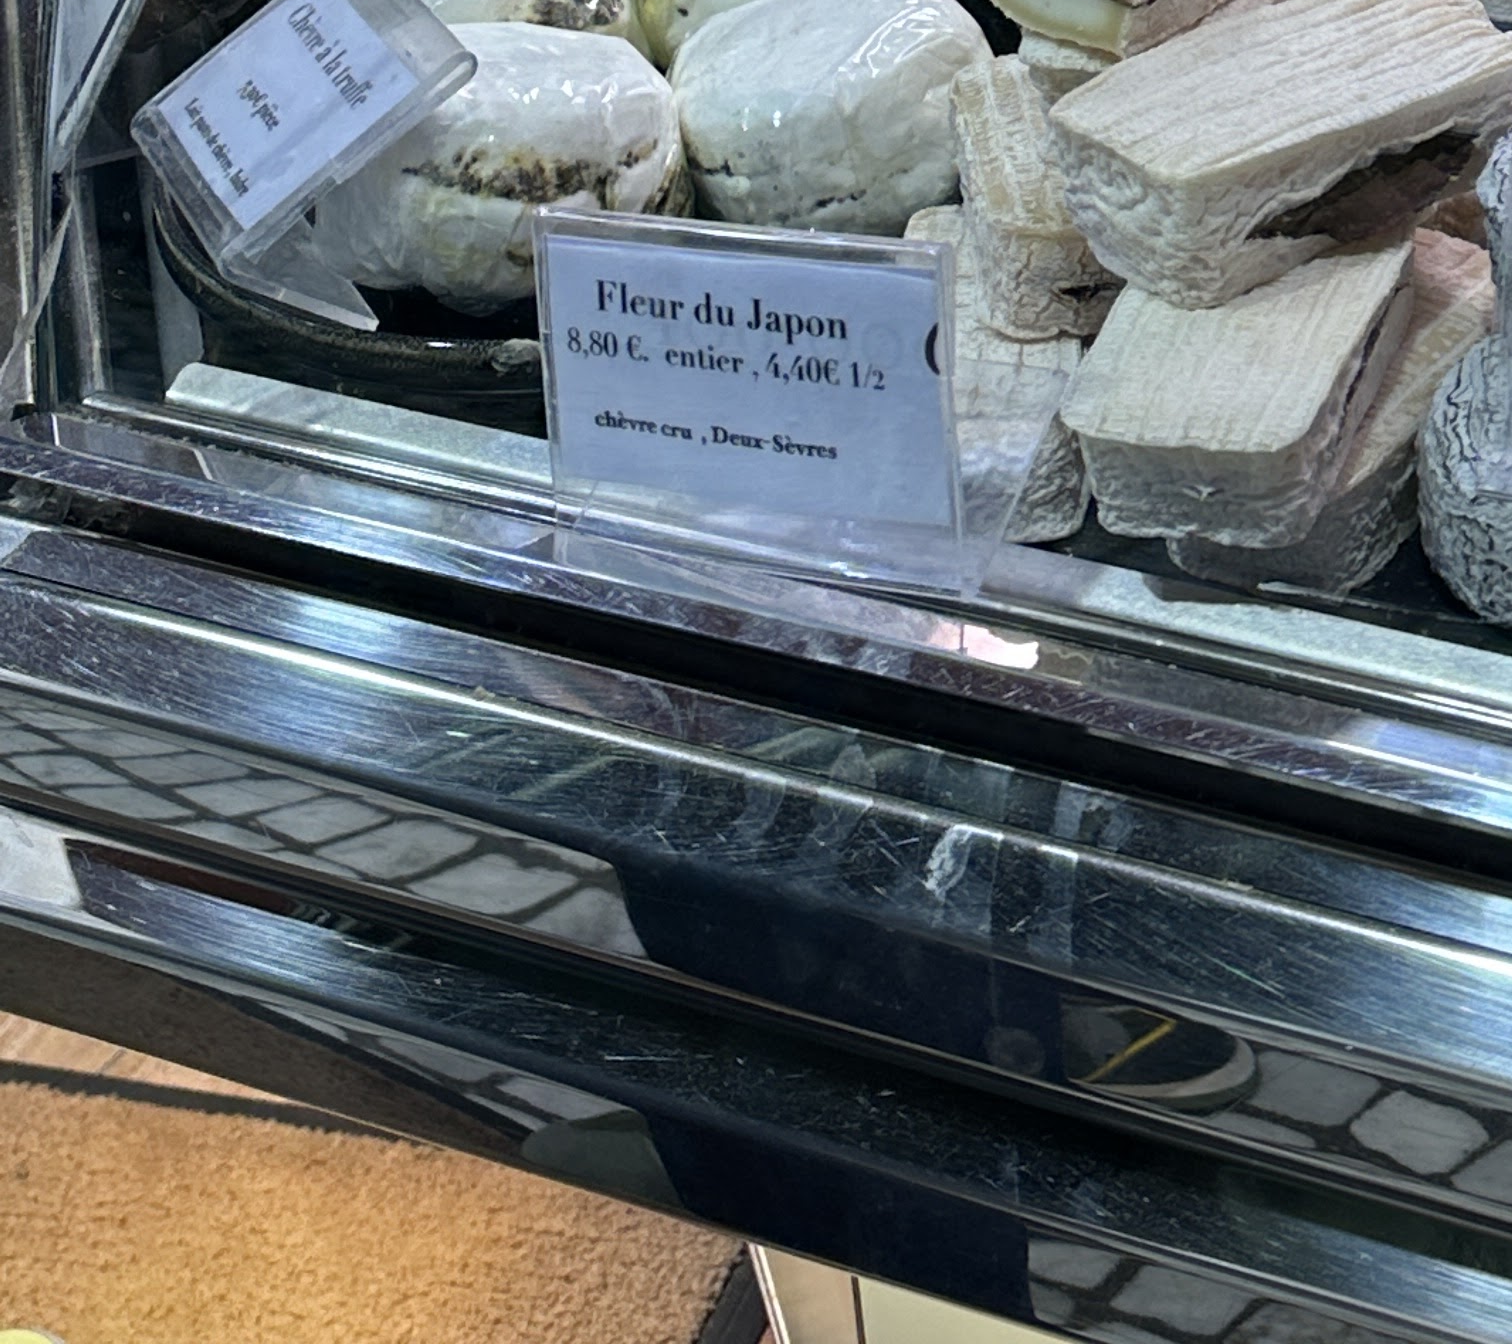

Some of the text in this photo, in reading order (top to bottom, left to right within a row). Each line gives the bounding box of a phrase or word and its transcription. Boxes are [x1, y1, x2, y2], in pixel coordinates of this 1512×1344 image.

[289, 3, 373, 108] Chèvre à la truffe
[595, 278, 848, 345] Fleur du Japon
[566, 326, 618, 360] 8,80
[664, 345, 746, 376] entier
[765, 351, 841, 387] 4,40€
[850, 360, 887, 392] 1/2
[594, 411, 839, 461] chèvre cru Deux-Sèvres
